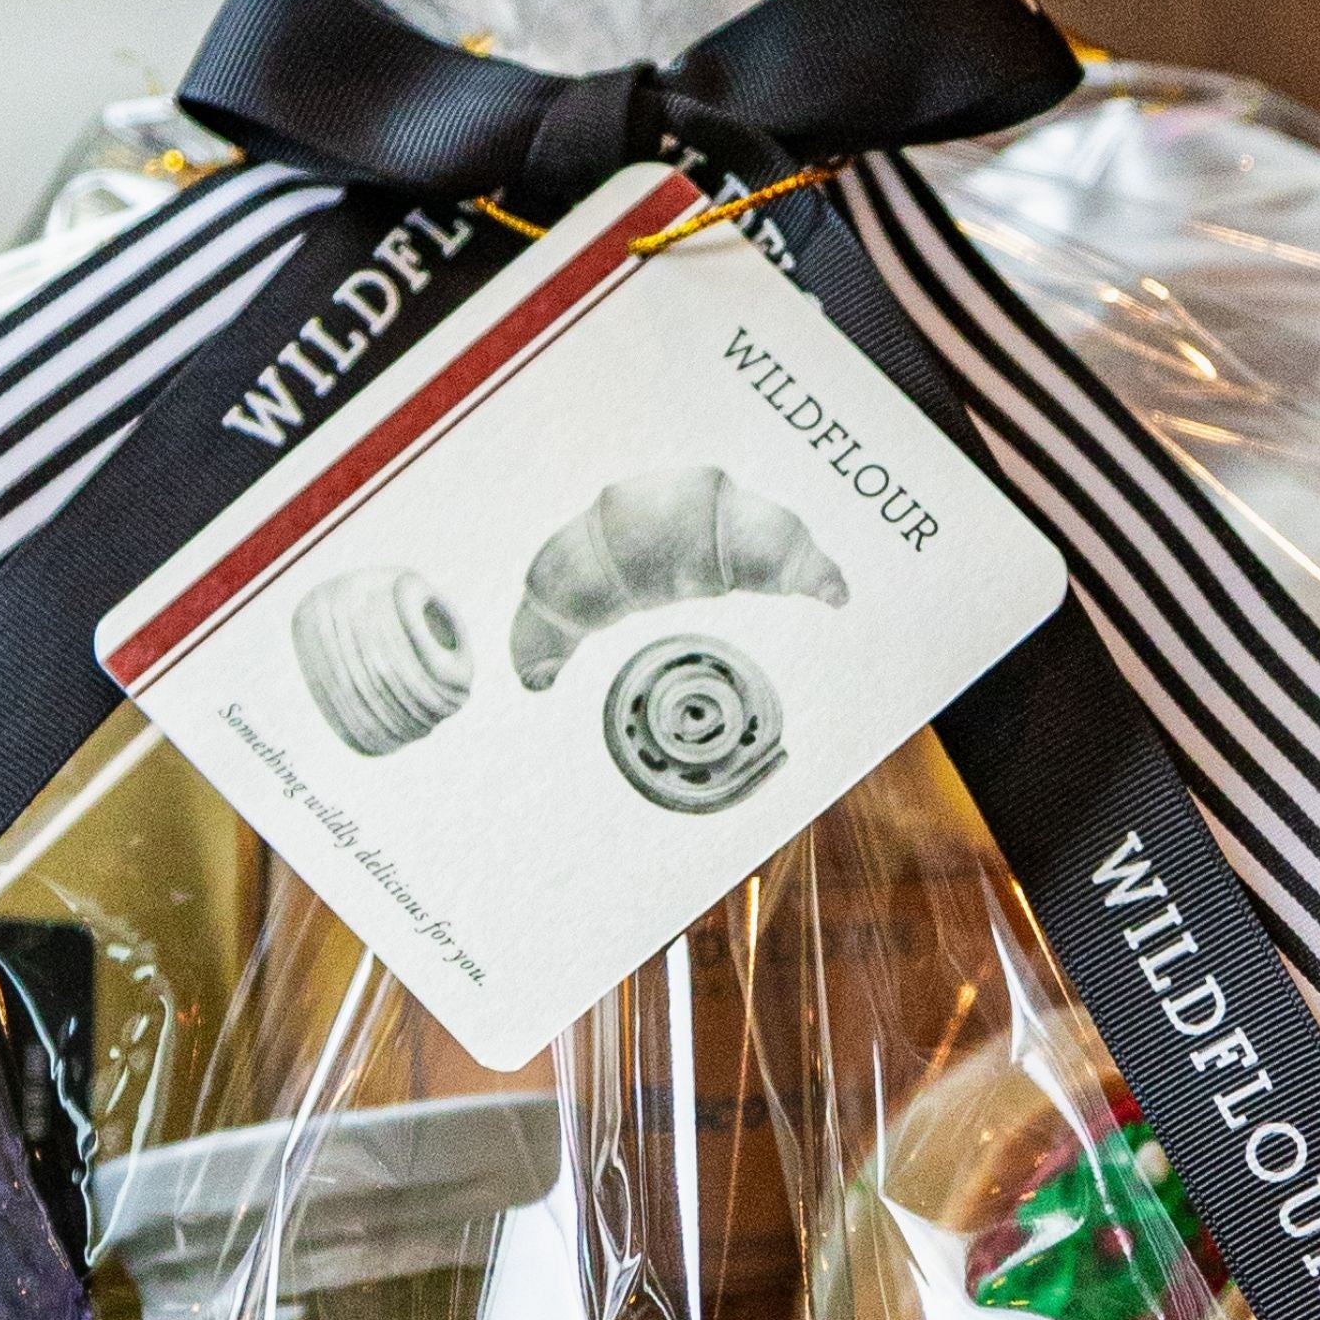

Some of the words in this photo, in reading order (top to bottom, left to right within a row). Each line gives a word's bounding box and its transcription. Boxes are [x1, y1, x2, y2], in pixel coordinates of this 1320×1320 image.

[222, 185, 506, 447] WILDFL
[723, 326, 939, 553] WILDFLOUR
[218, 702, 308, 799] Something
[302, 792, 360, 849] wildly
[354, 848, 430, 923] delicious
[415, 920, 456, 947] for
[442, 946, 484, 988] you.
